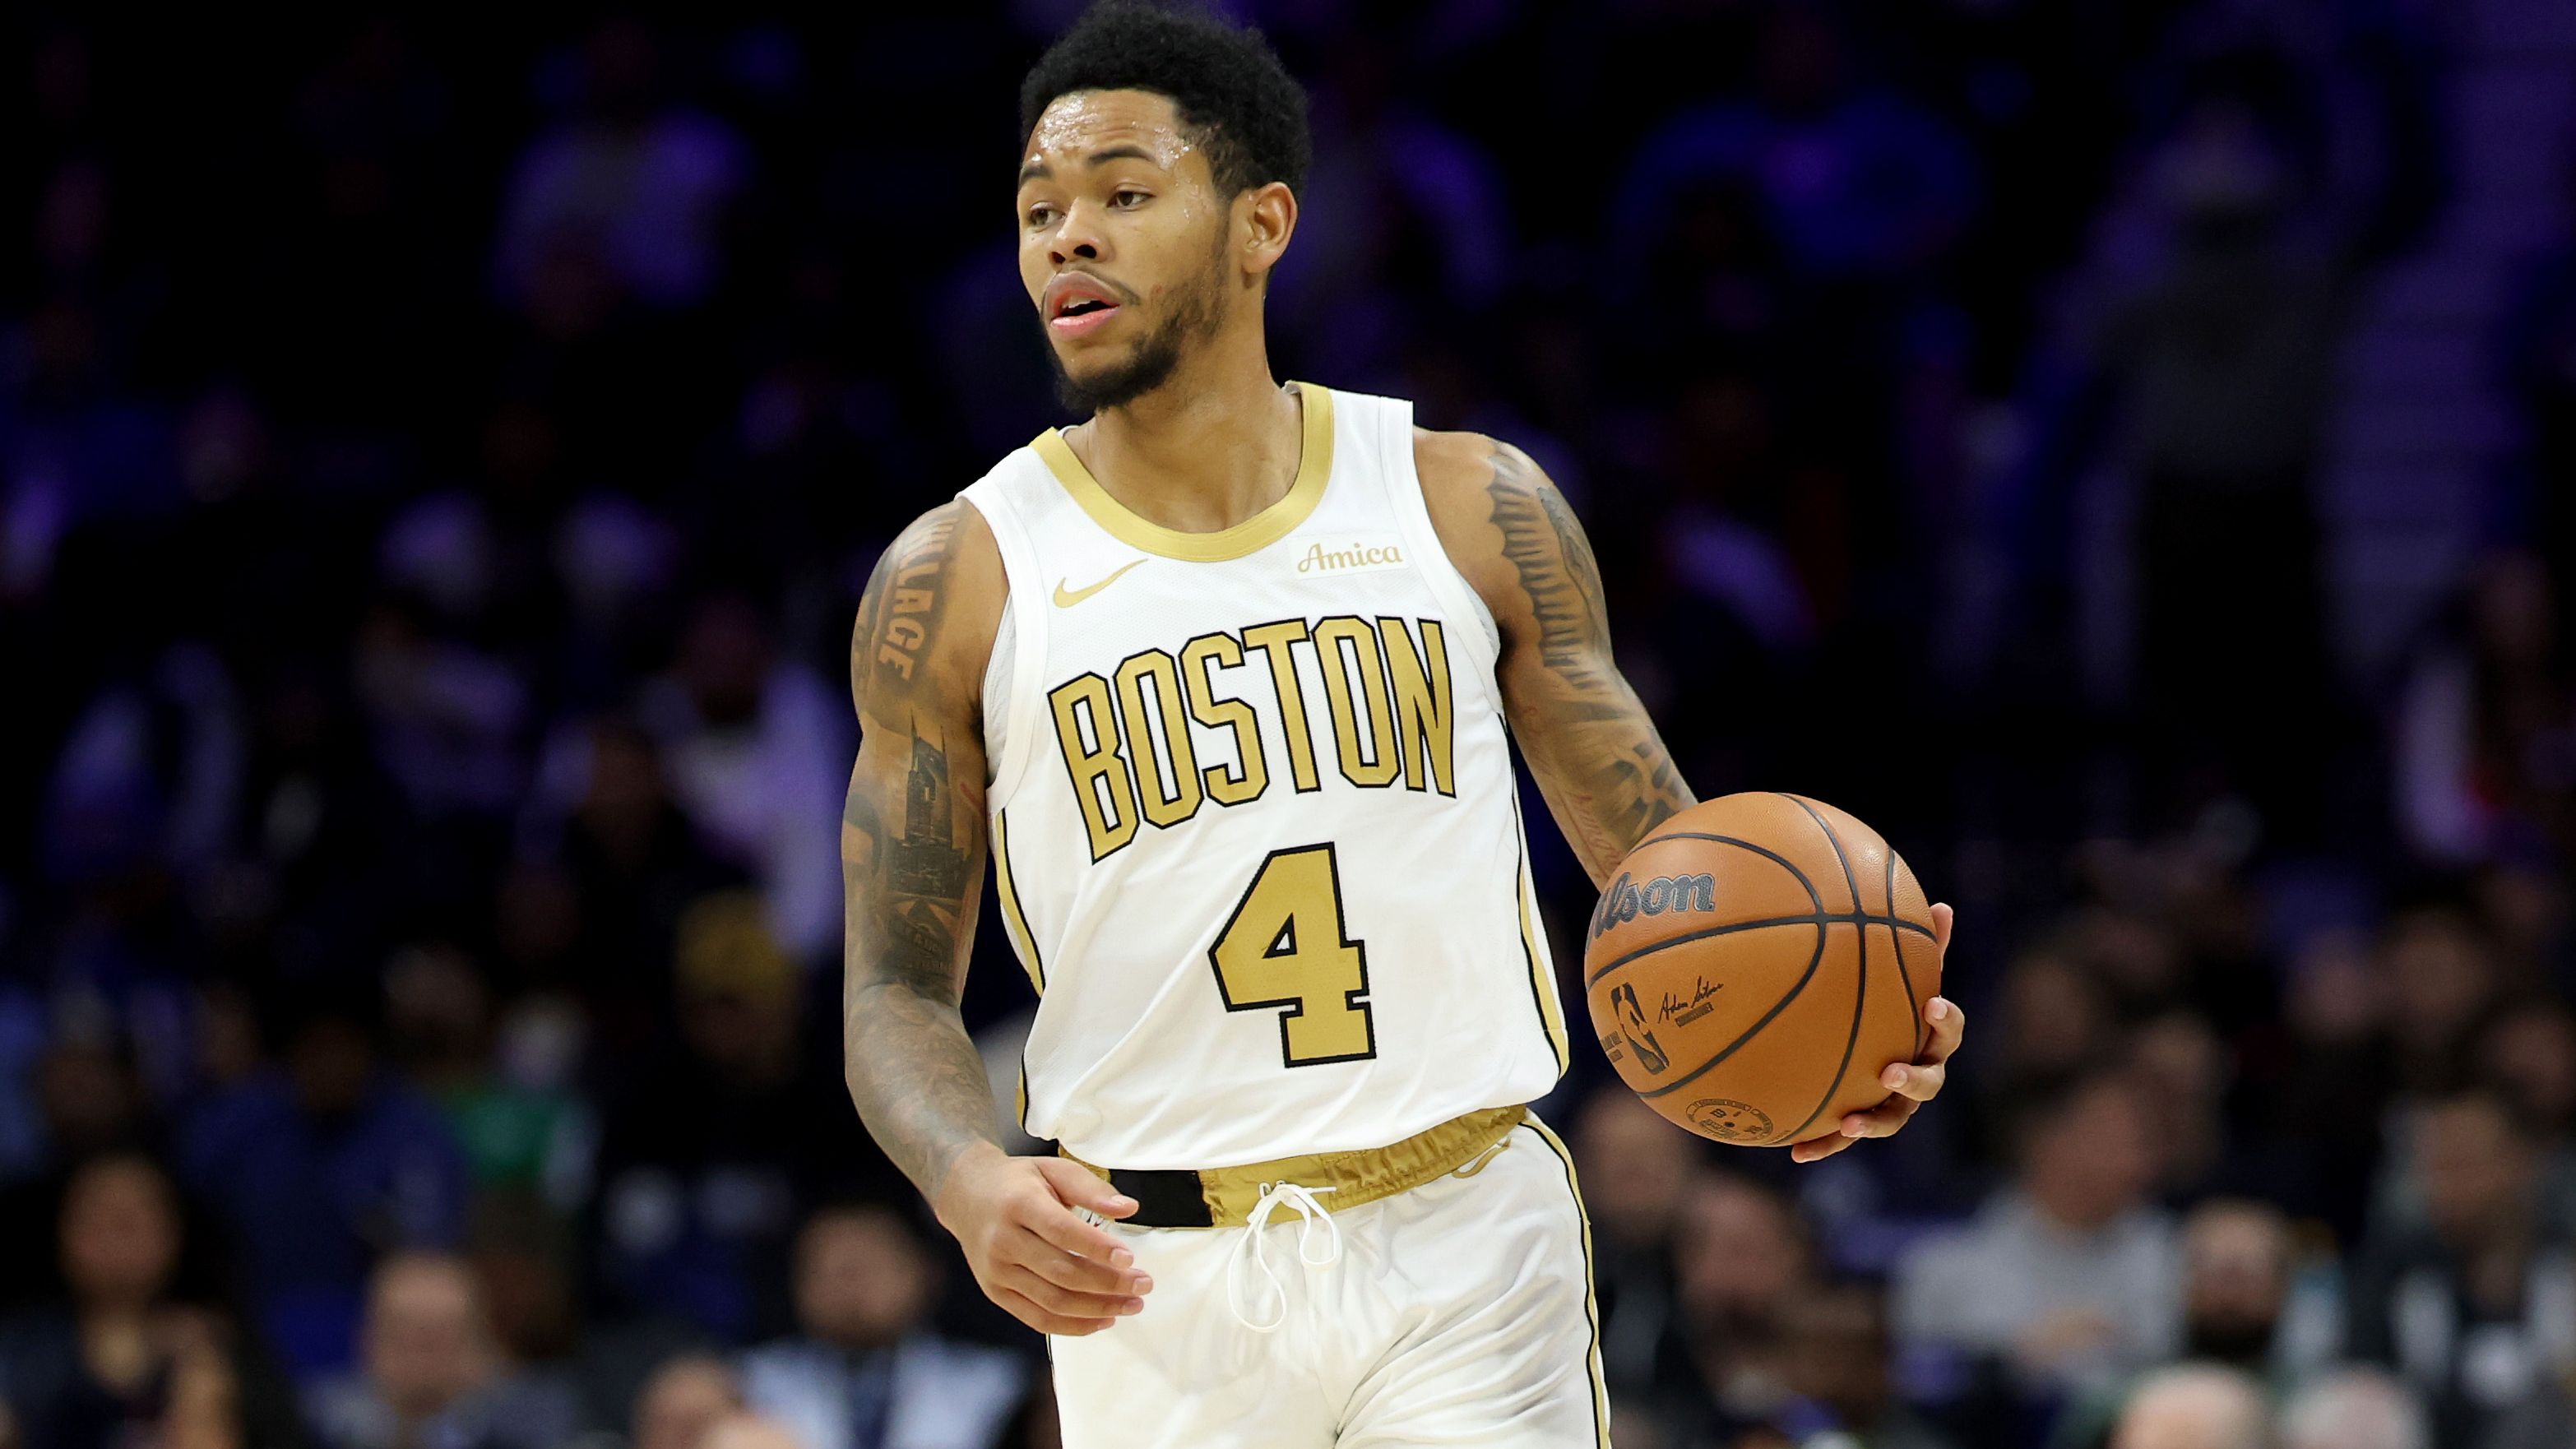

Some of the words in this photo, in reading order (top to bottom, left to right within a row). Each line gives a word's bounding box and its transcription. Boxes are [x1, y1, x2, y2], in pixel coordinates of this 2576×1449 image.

[1297, 542, 1403, 573] Amica
[1047, 614, 1457, 865] BOSTON
[1207, 840, 1376, 1068] 4
[1586, 872, 1715, 951] ilson
